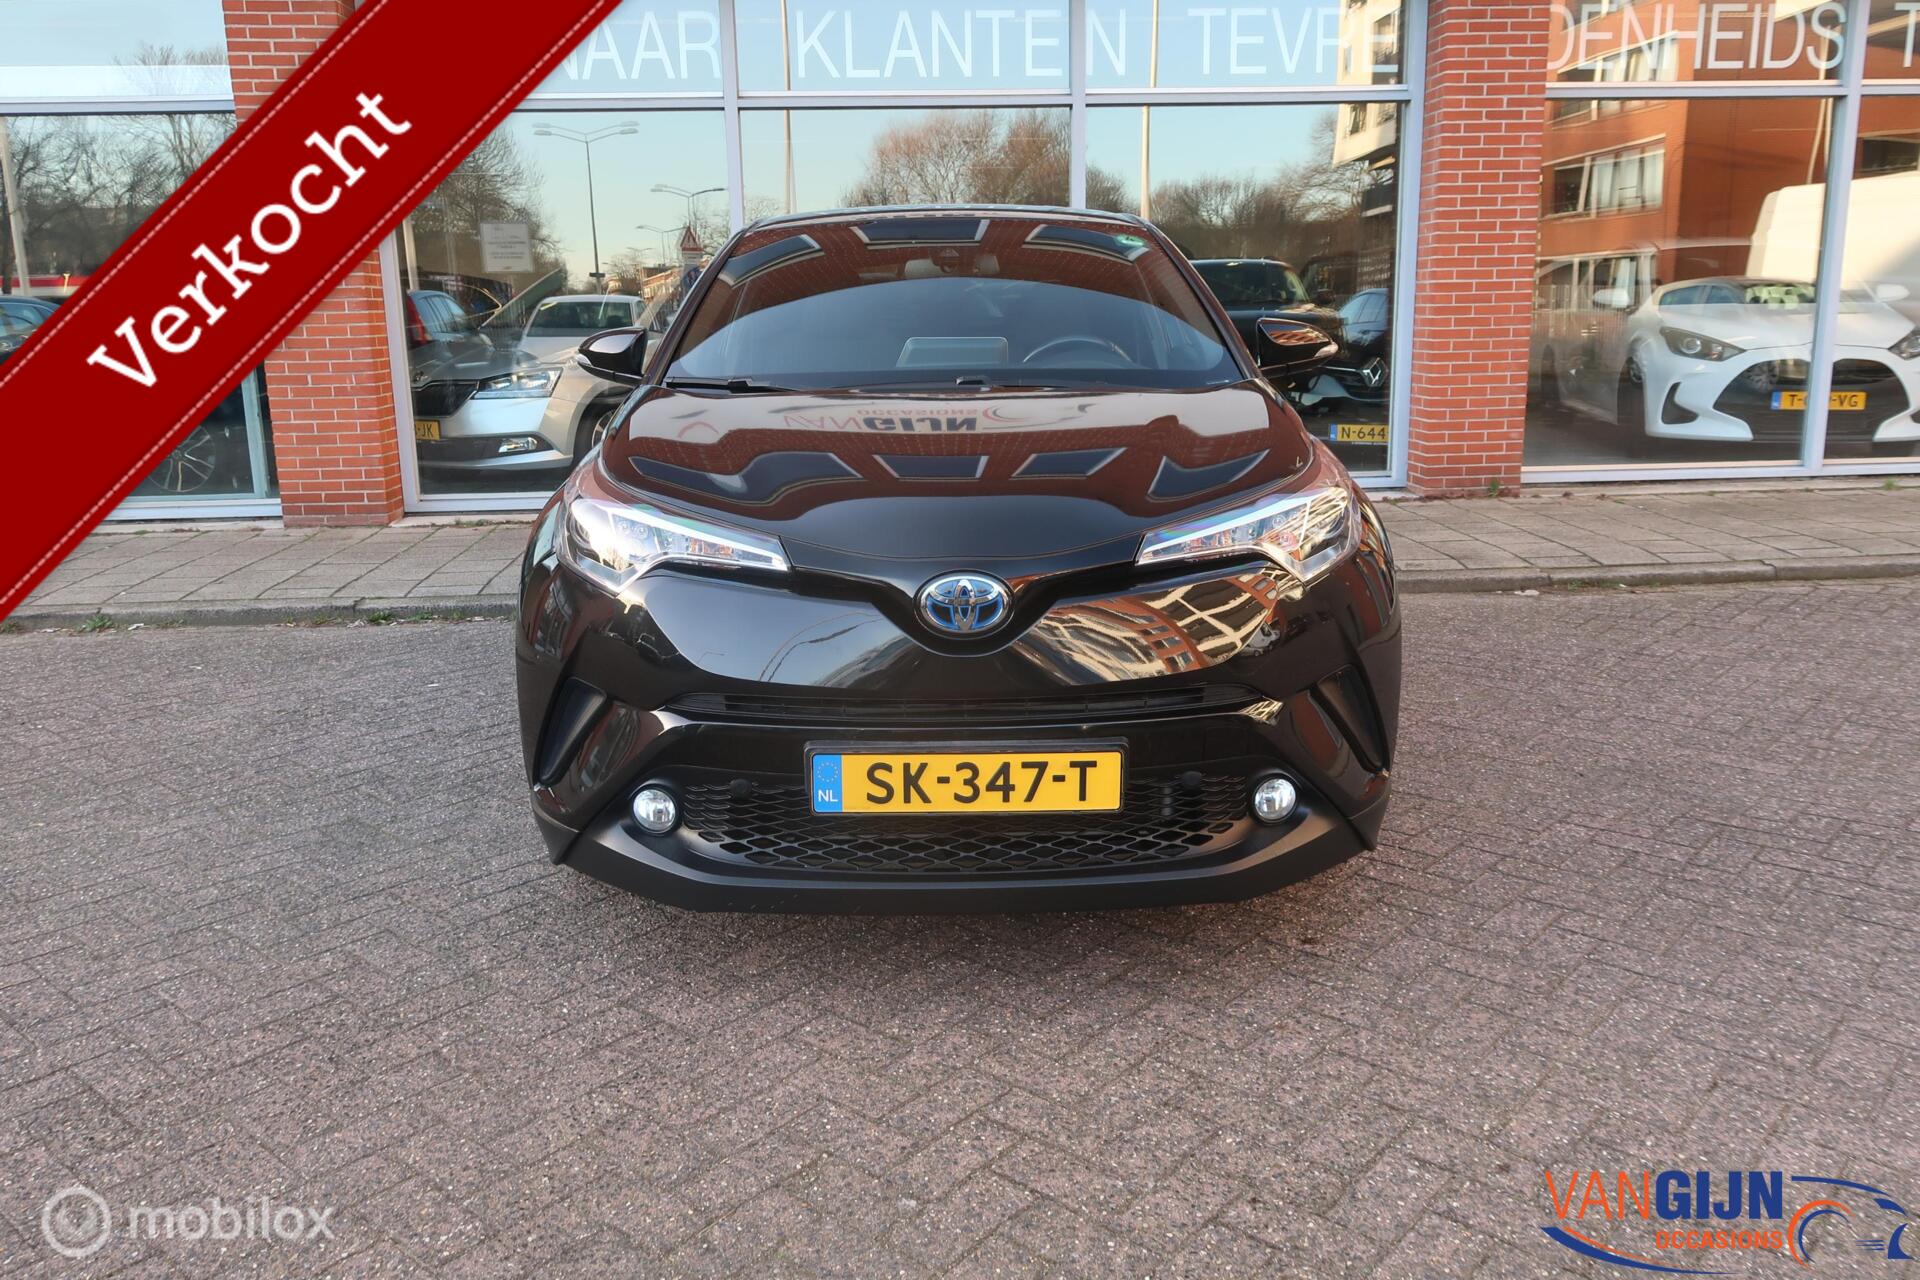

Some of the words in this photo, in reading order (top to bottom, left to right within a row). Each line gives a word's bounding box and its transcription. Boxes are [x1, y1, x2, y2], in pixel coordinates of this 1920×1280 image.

[796, 8, 1126, 78] KLANTEN
[818, 789, 838, 803] NL
[866, 761, 1097, 804] SK-347-T
